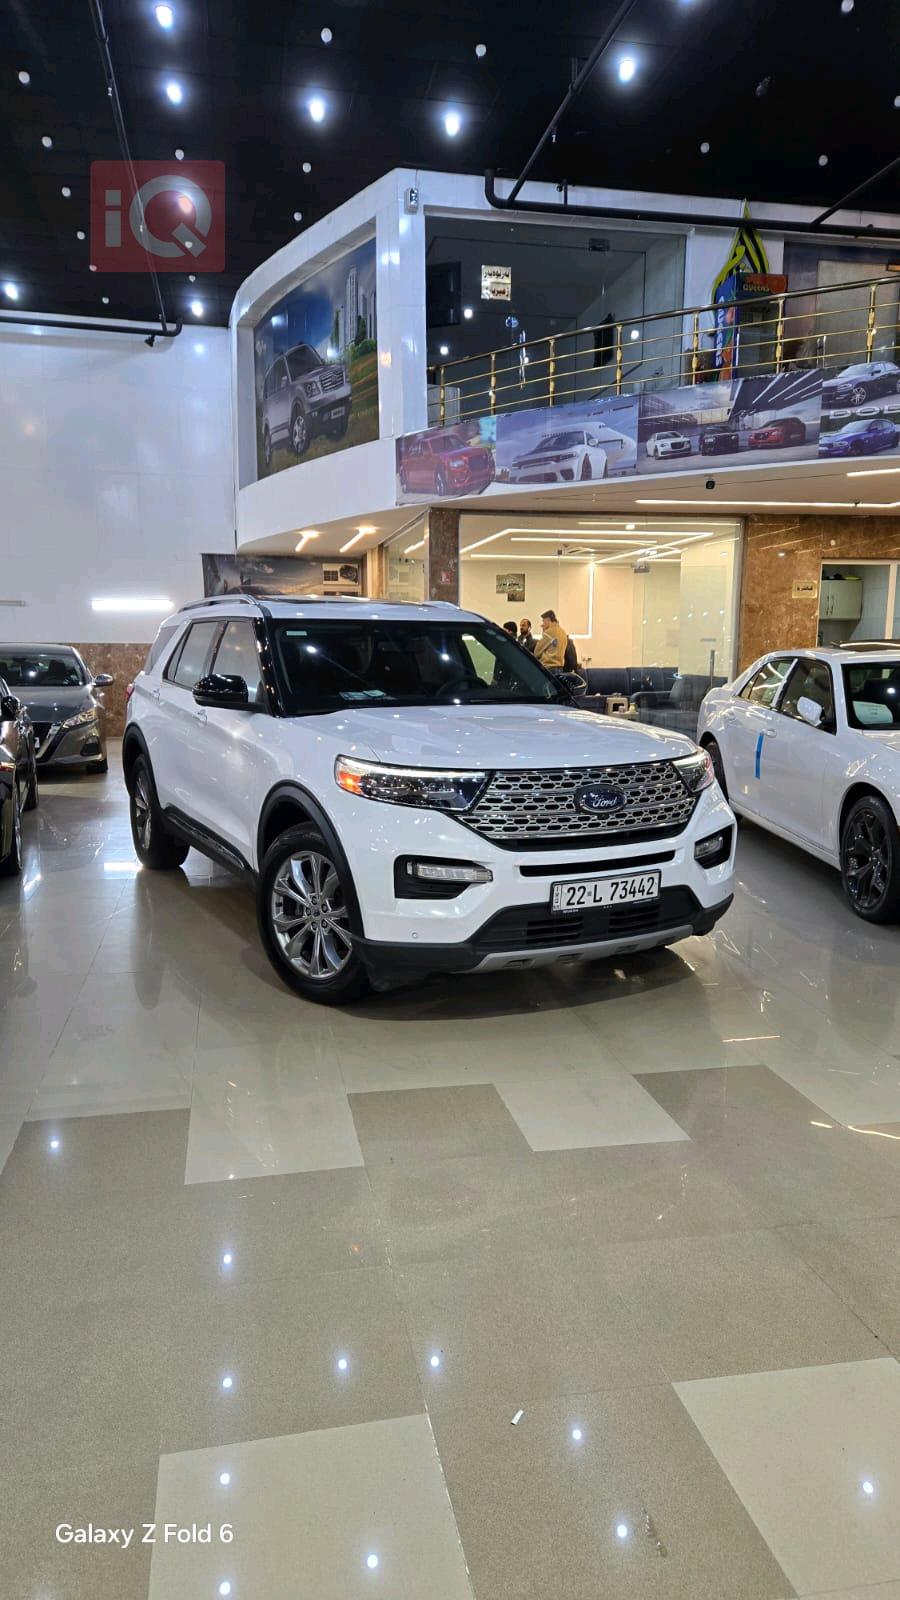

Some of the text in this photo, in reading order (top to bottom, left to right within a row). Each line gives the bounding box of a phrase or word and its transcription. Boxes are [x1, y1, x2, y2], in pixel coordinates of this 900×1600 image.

[591, 794, 618, 808] Ford
[566, 886, 586, 906] 22
[610, 876, 655, 902] 73442
